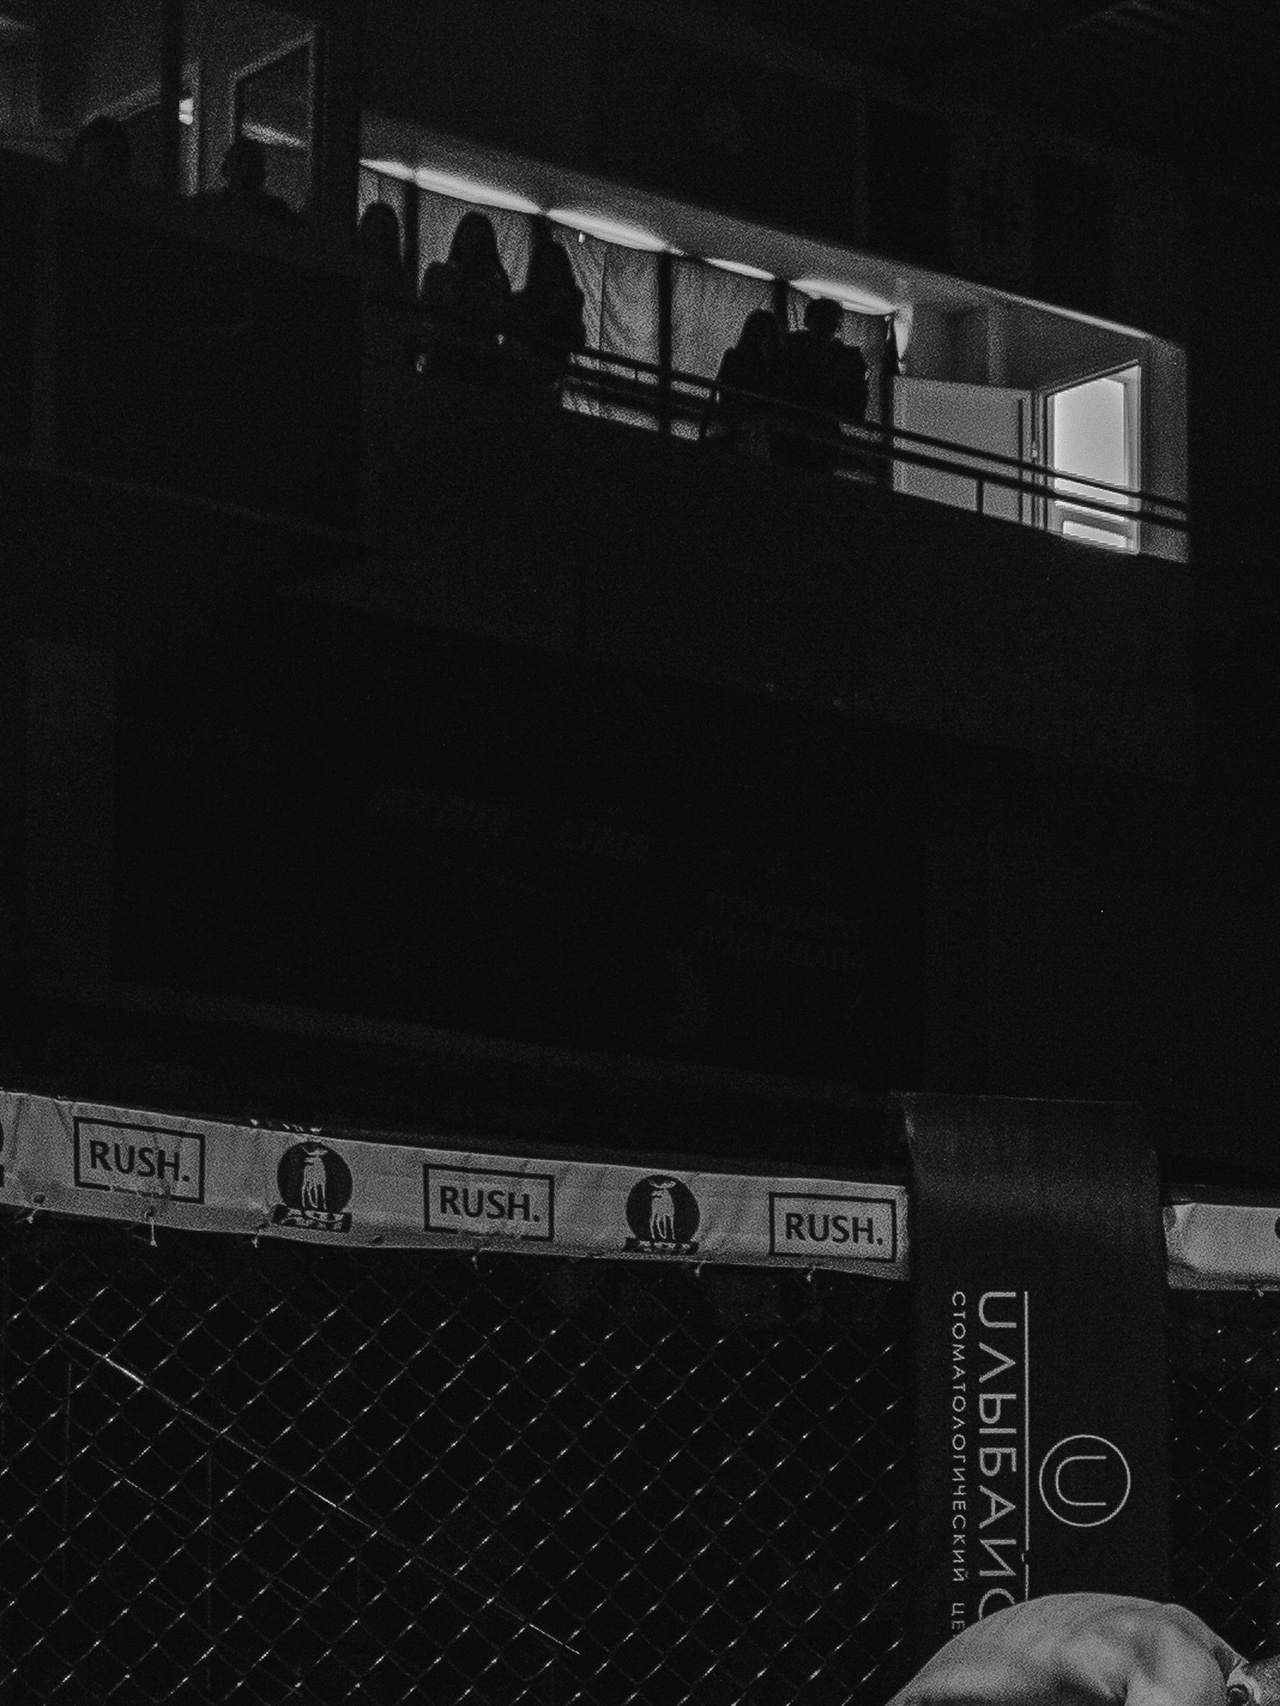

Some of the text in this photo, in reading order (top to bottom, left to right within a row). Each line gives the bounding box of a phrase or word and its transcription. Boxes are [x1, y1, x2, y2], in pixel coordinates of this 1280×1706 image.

[89, 1139, 191, 1183] RUSH.
[439, 1185, 540, 1223] RUSH.
[785, 1212, 884, 1246] RUSH.
[951, 1290, 969, 1582] СТОМАТОЛОГИЧЕСКИЙ
